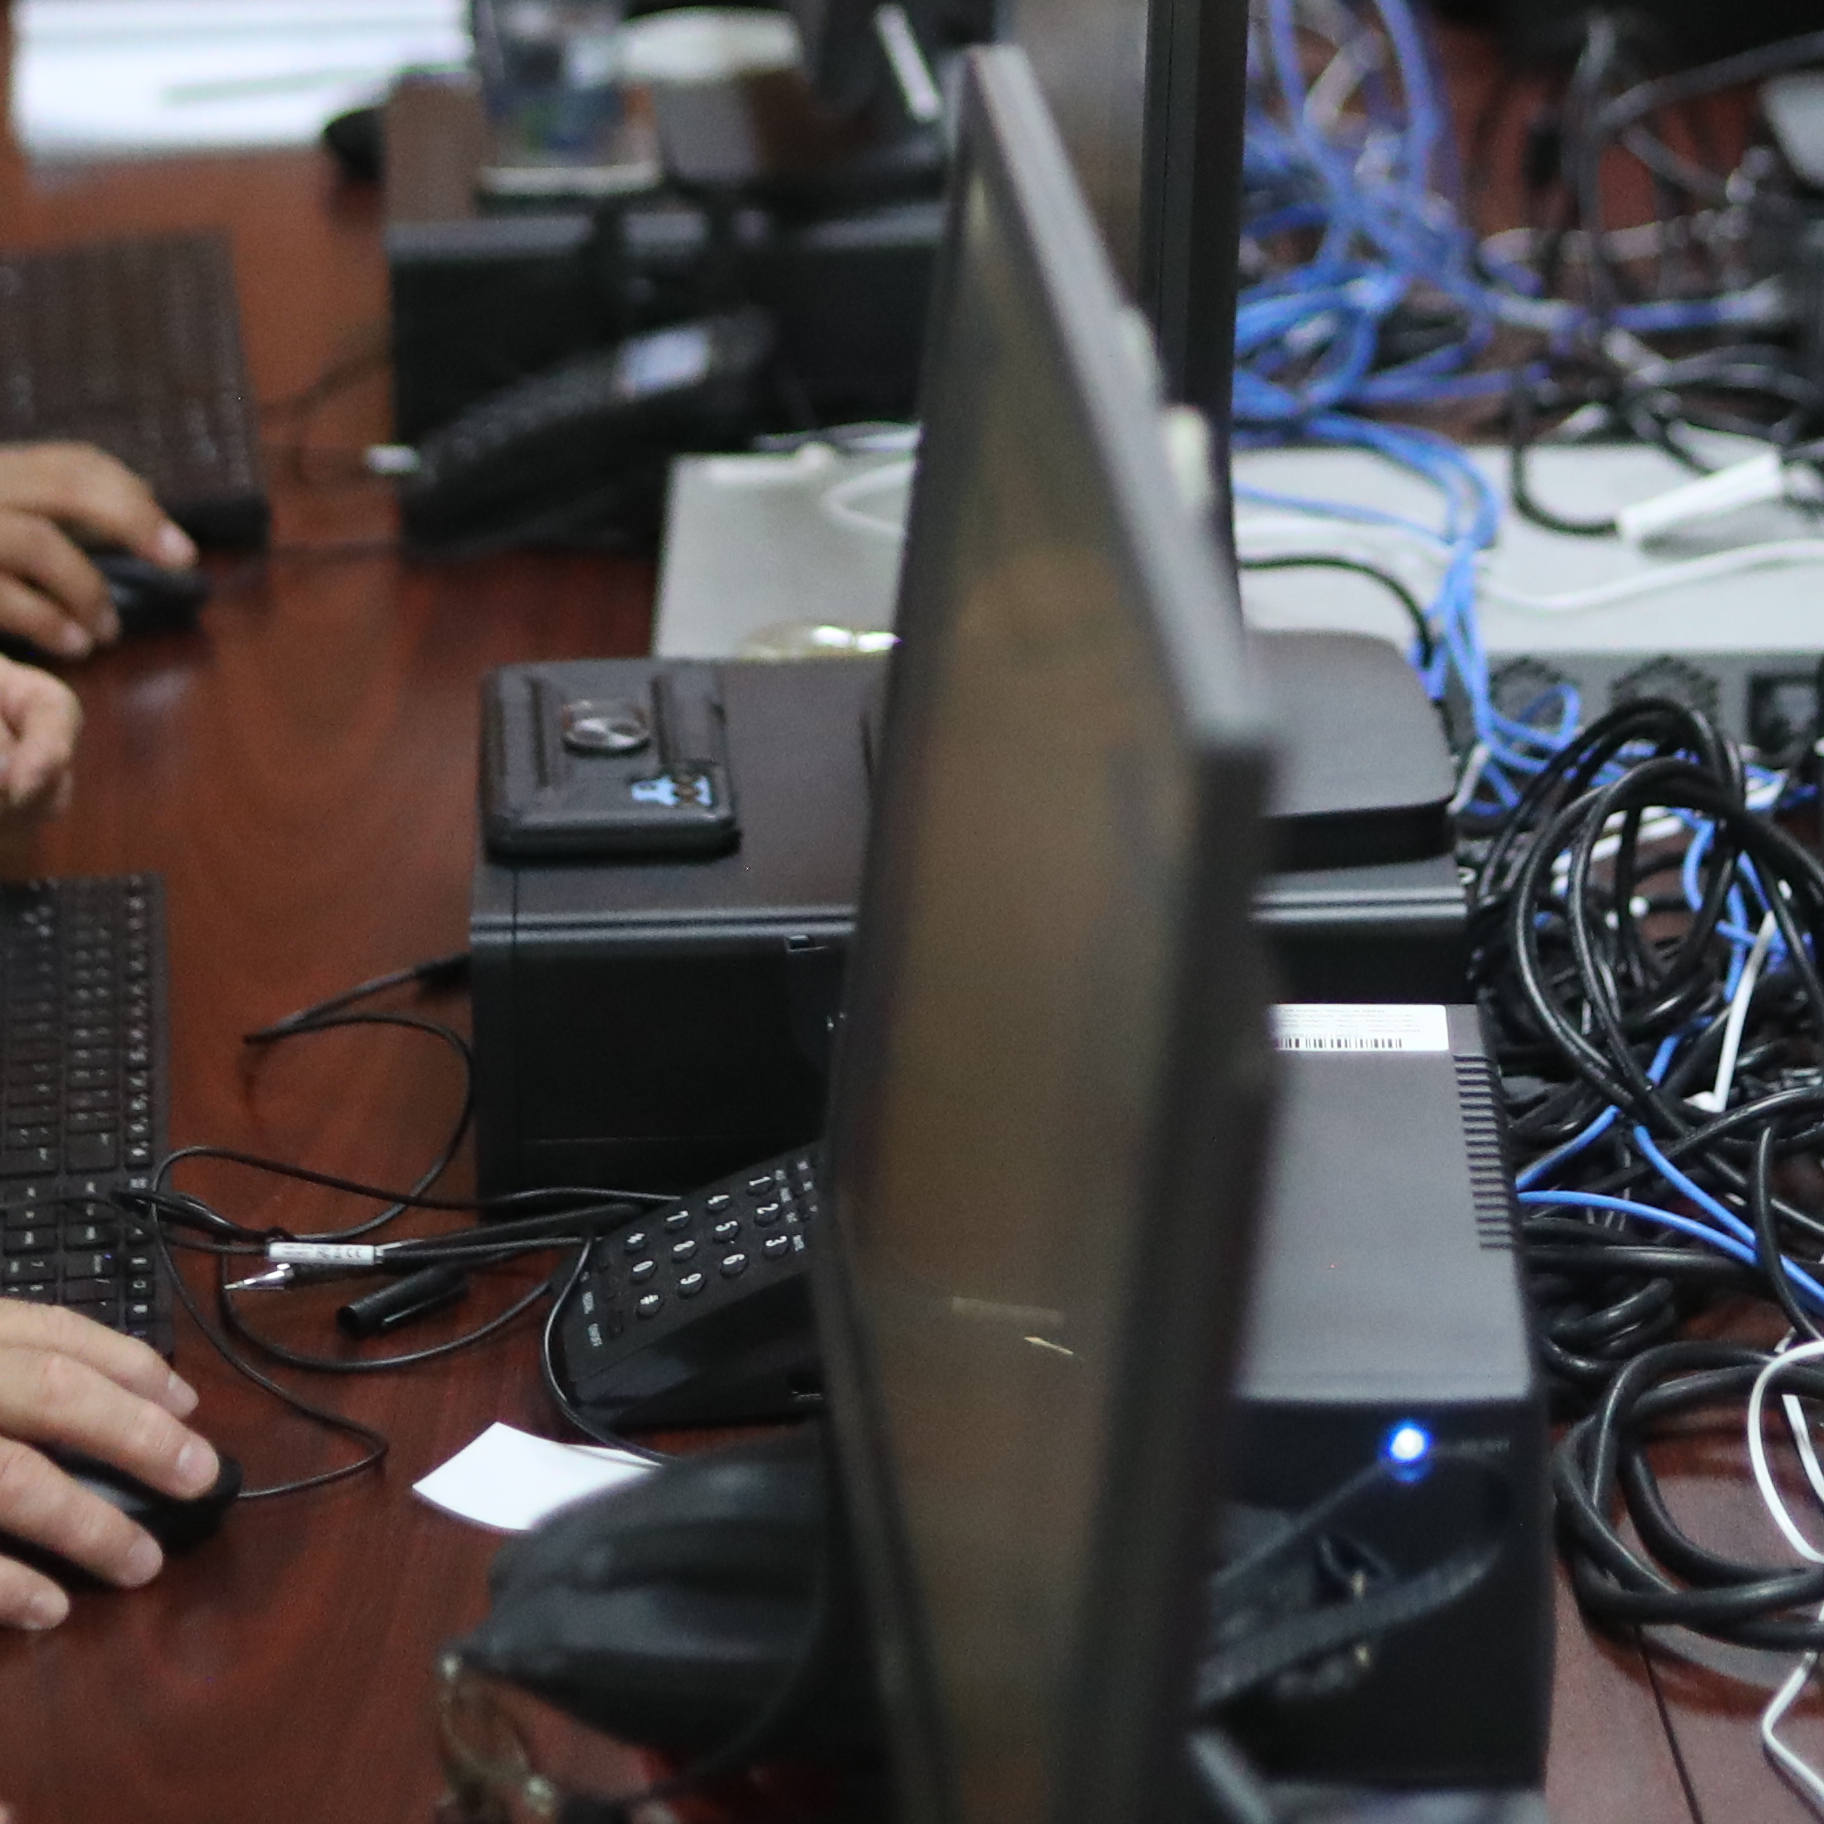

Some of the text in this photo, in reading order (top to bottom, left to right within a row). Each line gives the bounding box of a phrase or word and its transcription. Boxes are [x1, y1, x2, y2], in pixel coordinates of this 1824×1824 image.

[749, 1176, 788, 1247] 1 2 3
[714, 1220, 738, 1232] 5
[666, 1210, 689, 1222] 7
[679, 1272, 702, 1285] 9
[722, 1253, 745, 1265] 6
[632, 1260, 654, 1273] 0
